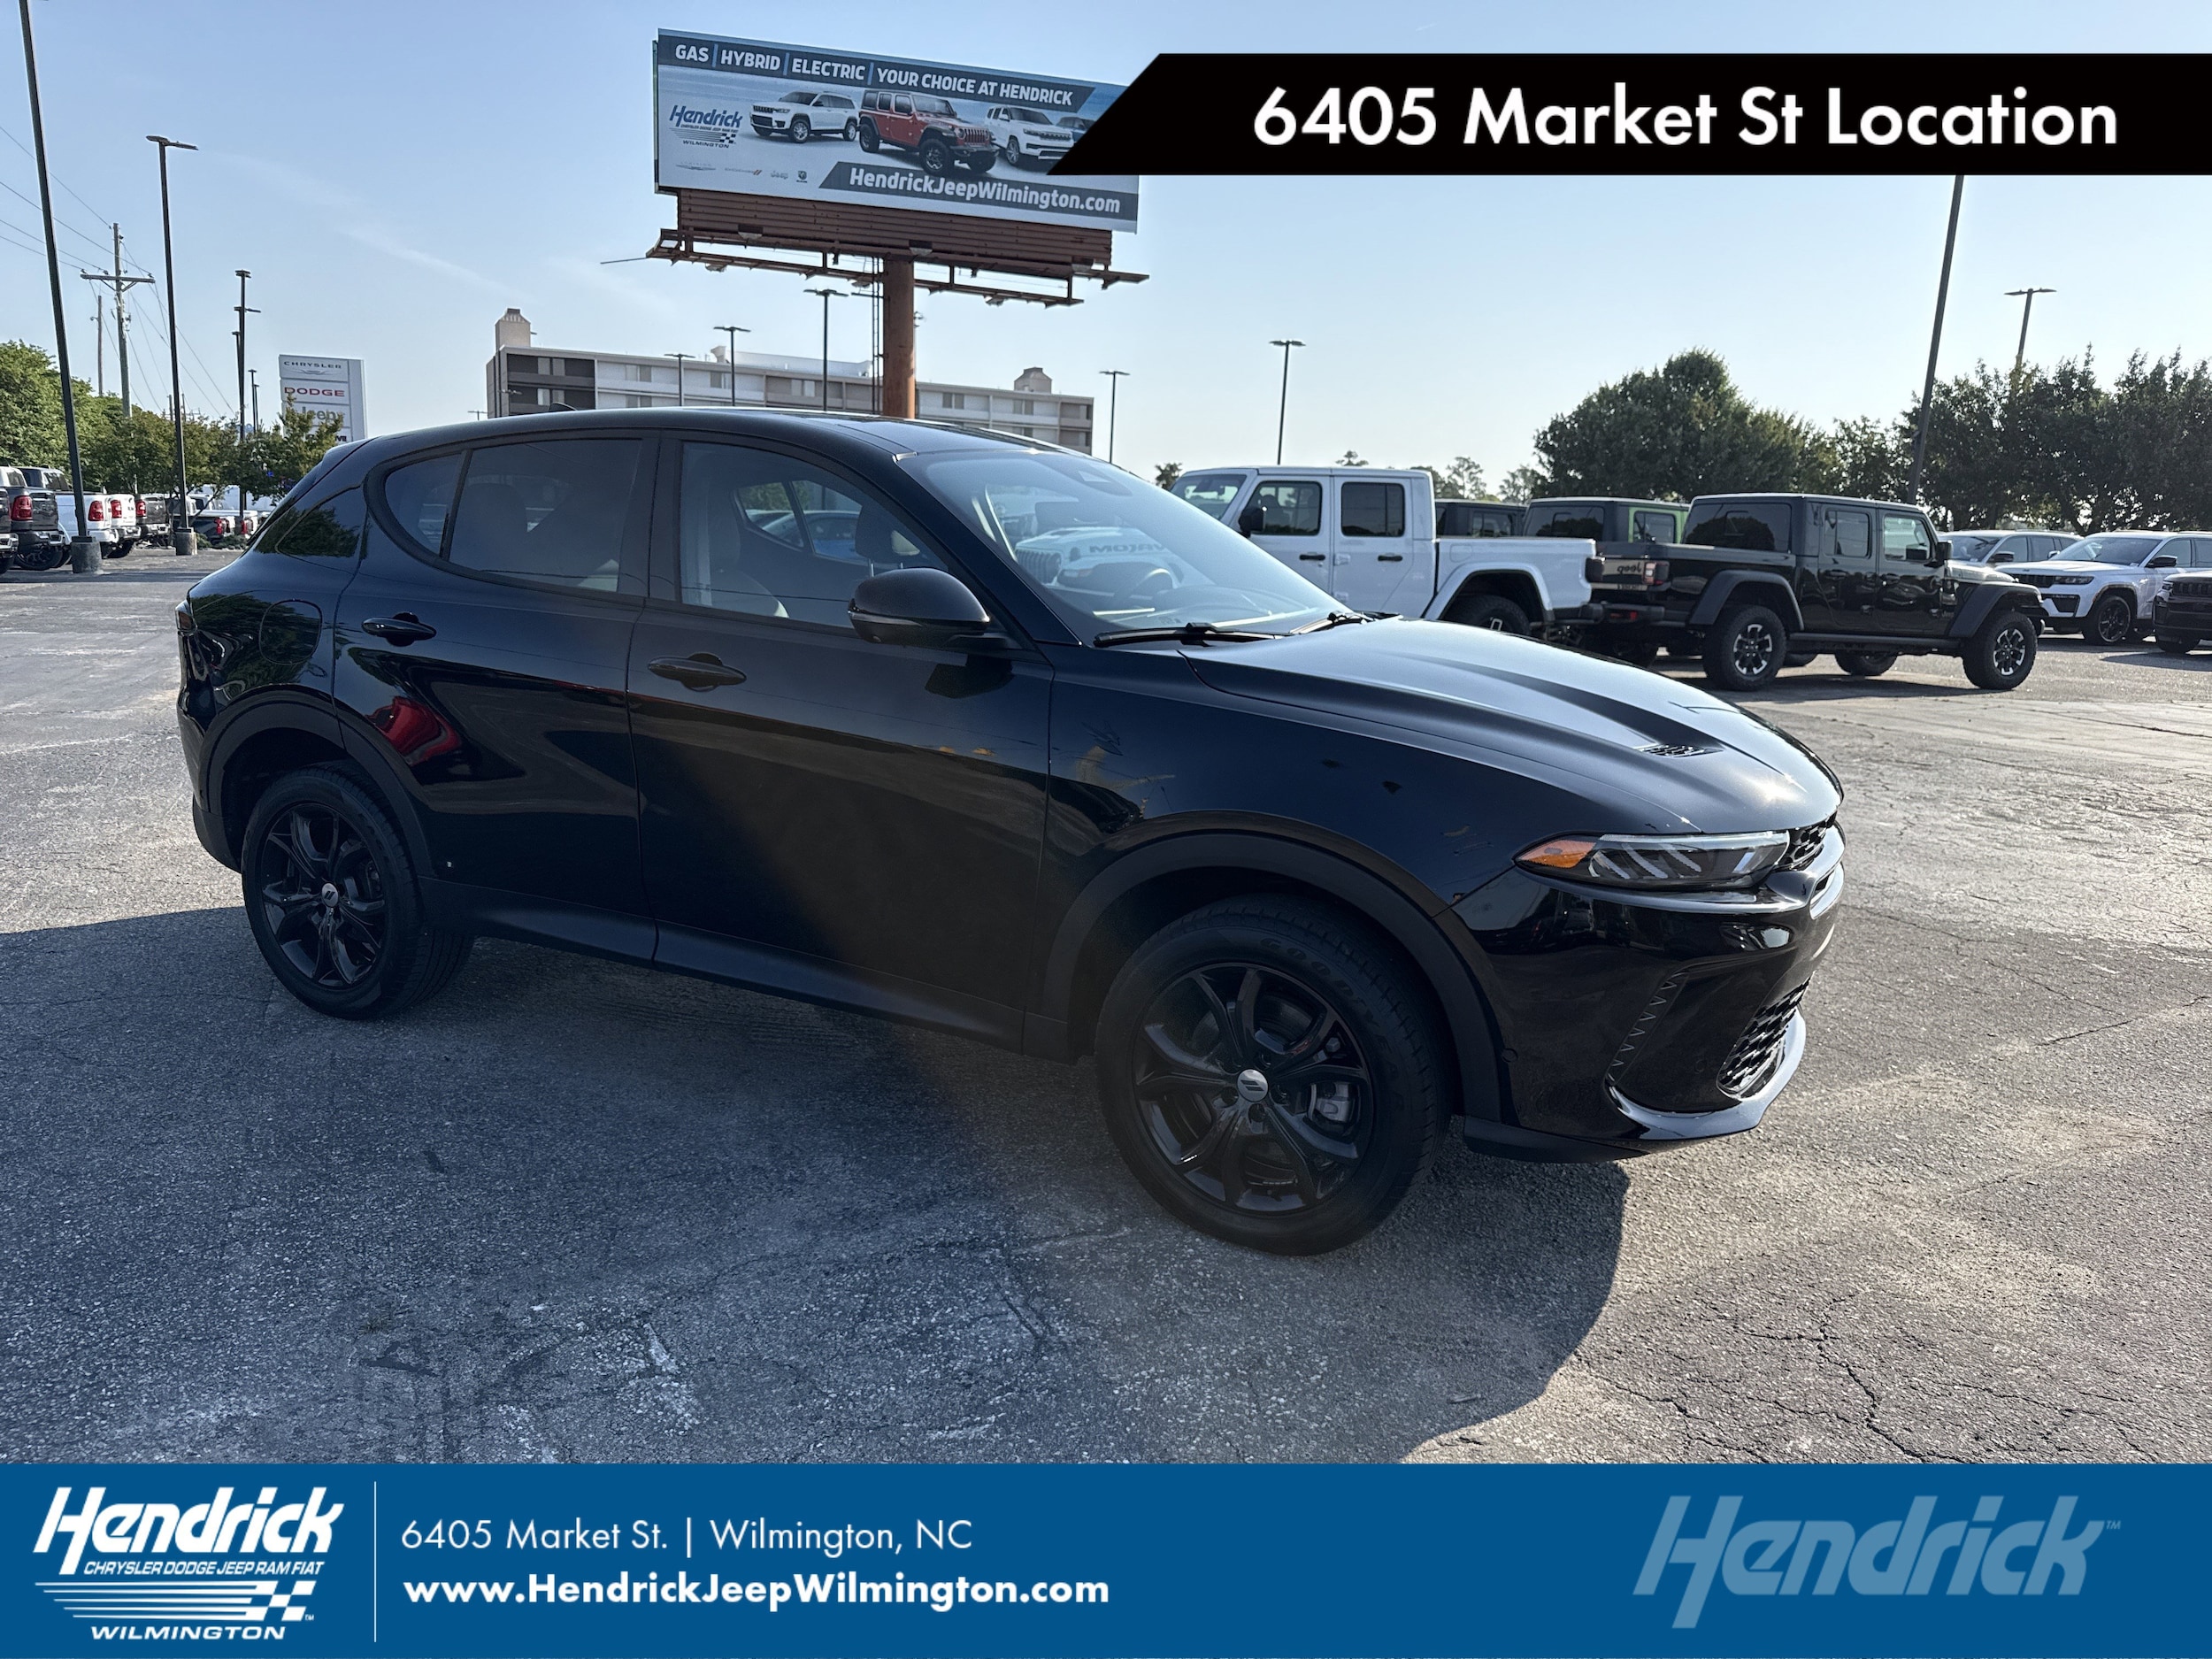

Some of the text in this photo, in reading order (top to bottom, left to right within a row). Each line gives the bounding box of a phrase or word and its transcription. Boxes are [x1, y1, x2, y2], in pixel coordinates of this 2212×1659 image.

[675, 44, 1073, 106] GAS HYBRID ELECTRIC YOUR CHOICE AT HENDRICK
[669, 104, 743, 128] Hendrick
[682, 140, 730, 149] WILMINGTON
[849, 167, 1121, 214] HendrickJeepWilmington.com
[283, 360, 342, 369] CHRYSLER
[283, 386, 346, 397] DODGE
